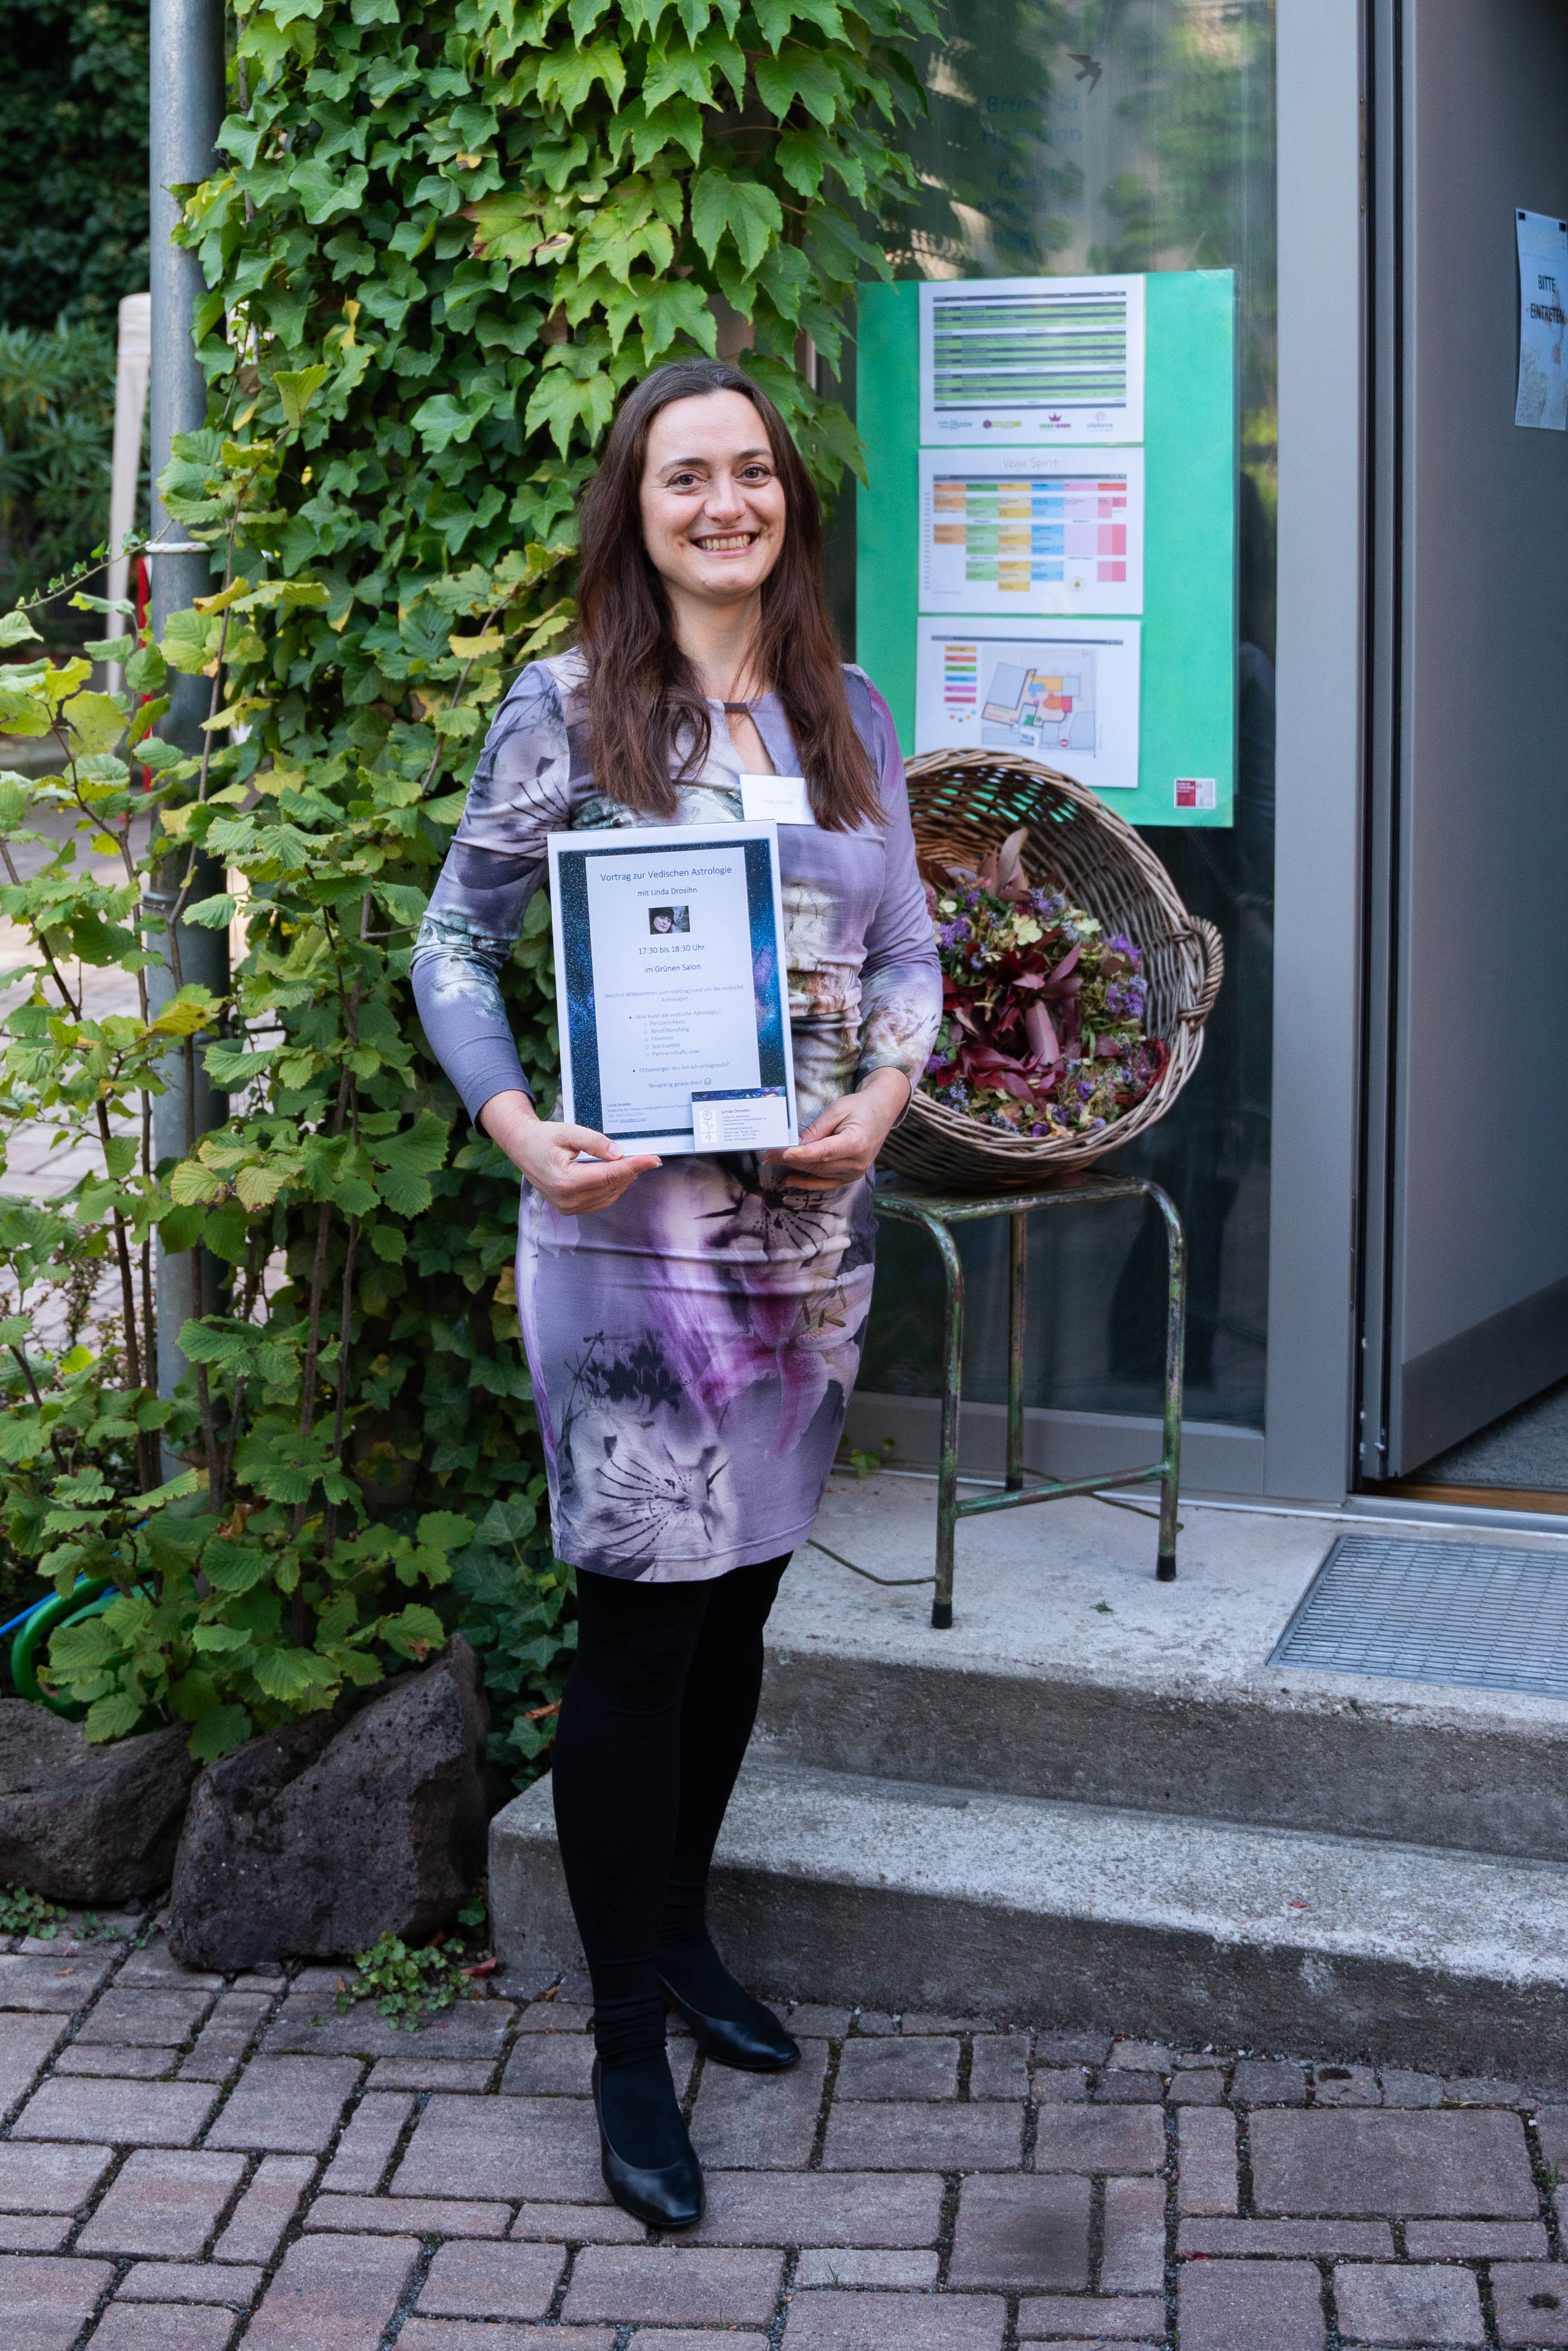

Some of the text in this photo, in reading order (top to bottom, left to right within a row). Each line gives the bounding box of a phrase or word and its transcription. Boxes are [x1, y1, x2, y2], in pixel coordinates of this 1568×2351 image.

[1538, 275, 1556, 292] BITTE
[1530, 303, 1565, 324] EINTRETEN
[648, 869, 689, 878] Vedischen
[692, 866, 732, 875] Astrologie
